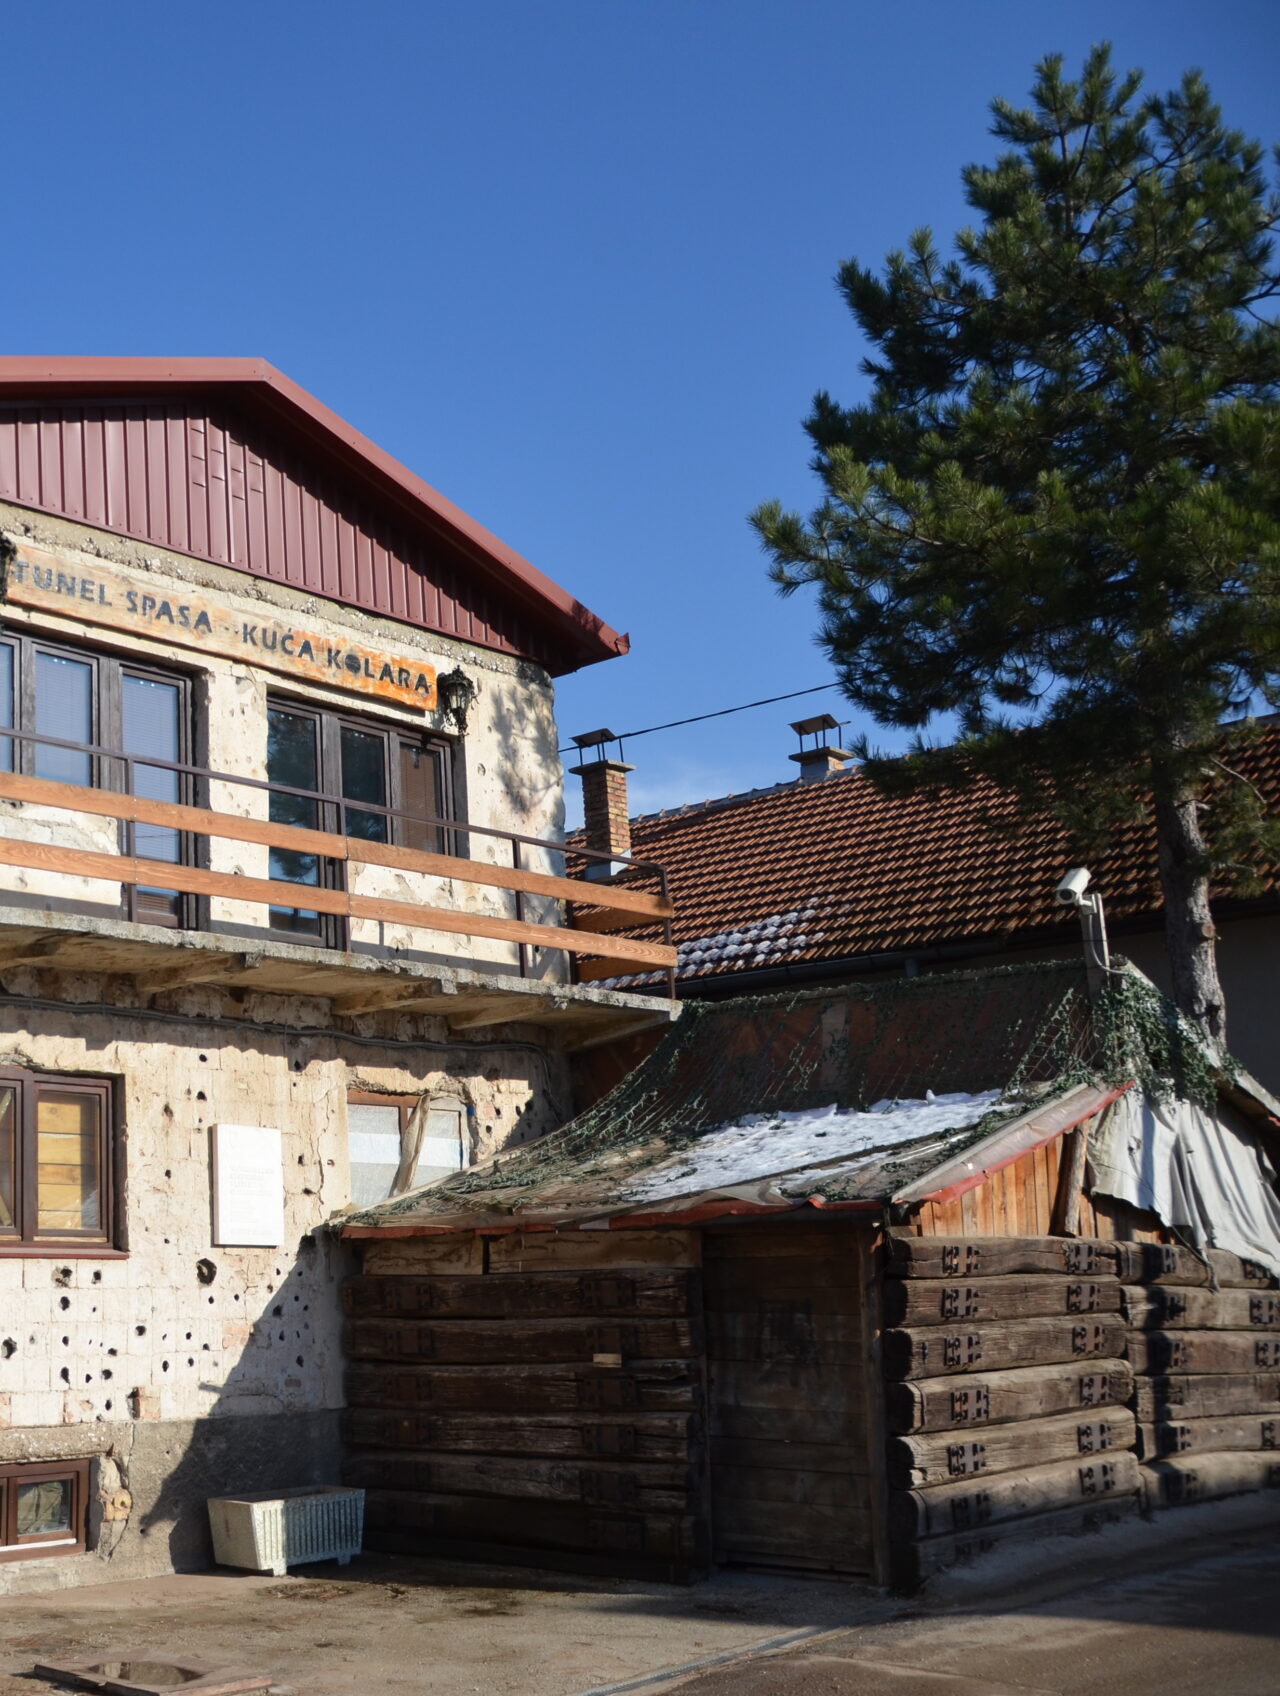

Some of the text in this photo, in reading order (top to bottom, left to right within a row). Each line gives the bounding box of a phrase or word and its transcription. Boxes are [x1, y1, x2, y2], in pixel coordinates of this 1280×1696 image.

[13, 560, 112, 607] TUNEL
[126, 590, 212, 634] SPASA
[242, 622, 315, 662] KUĆA
[326, 646, 433, 694] KOLARA
